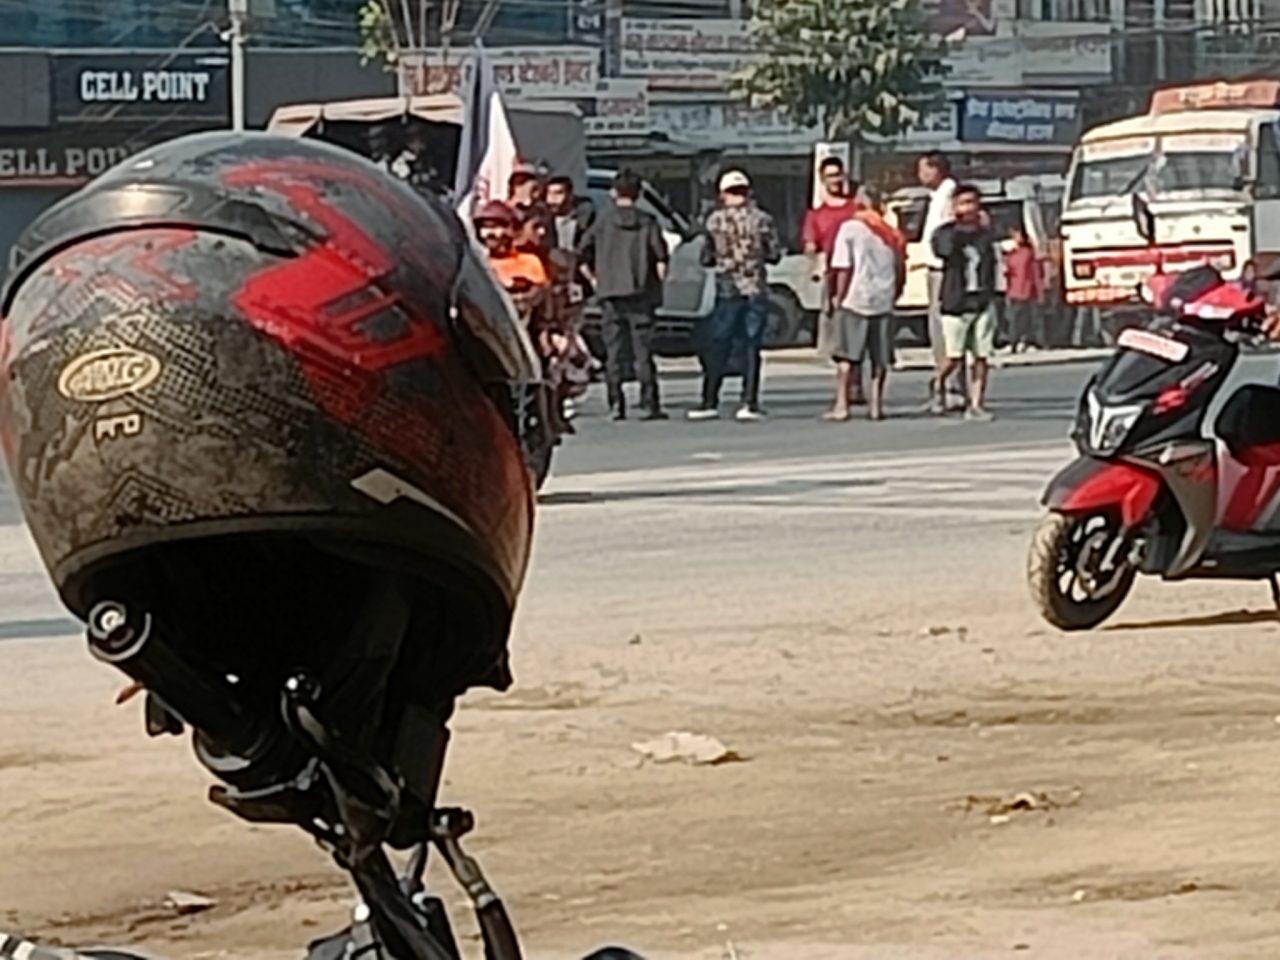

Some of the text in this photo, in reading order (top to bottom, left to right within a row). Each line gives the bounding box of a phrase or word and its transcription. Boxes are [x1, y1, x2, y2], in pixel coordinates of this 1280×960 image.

[81, 70, 210, 101] CELL POINT
[0, 147, 57, 175] ELL
